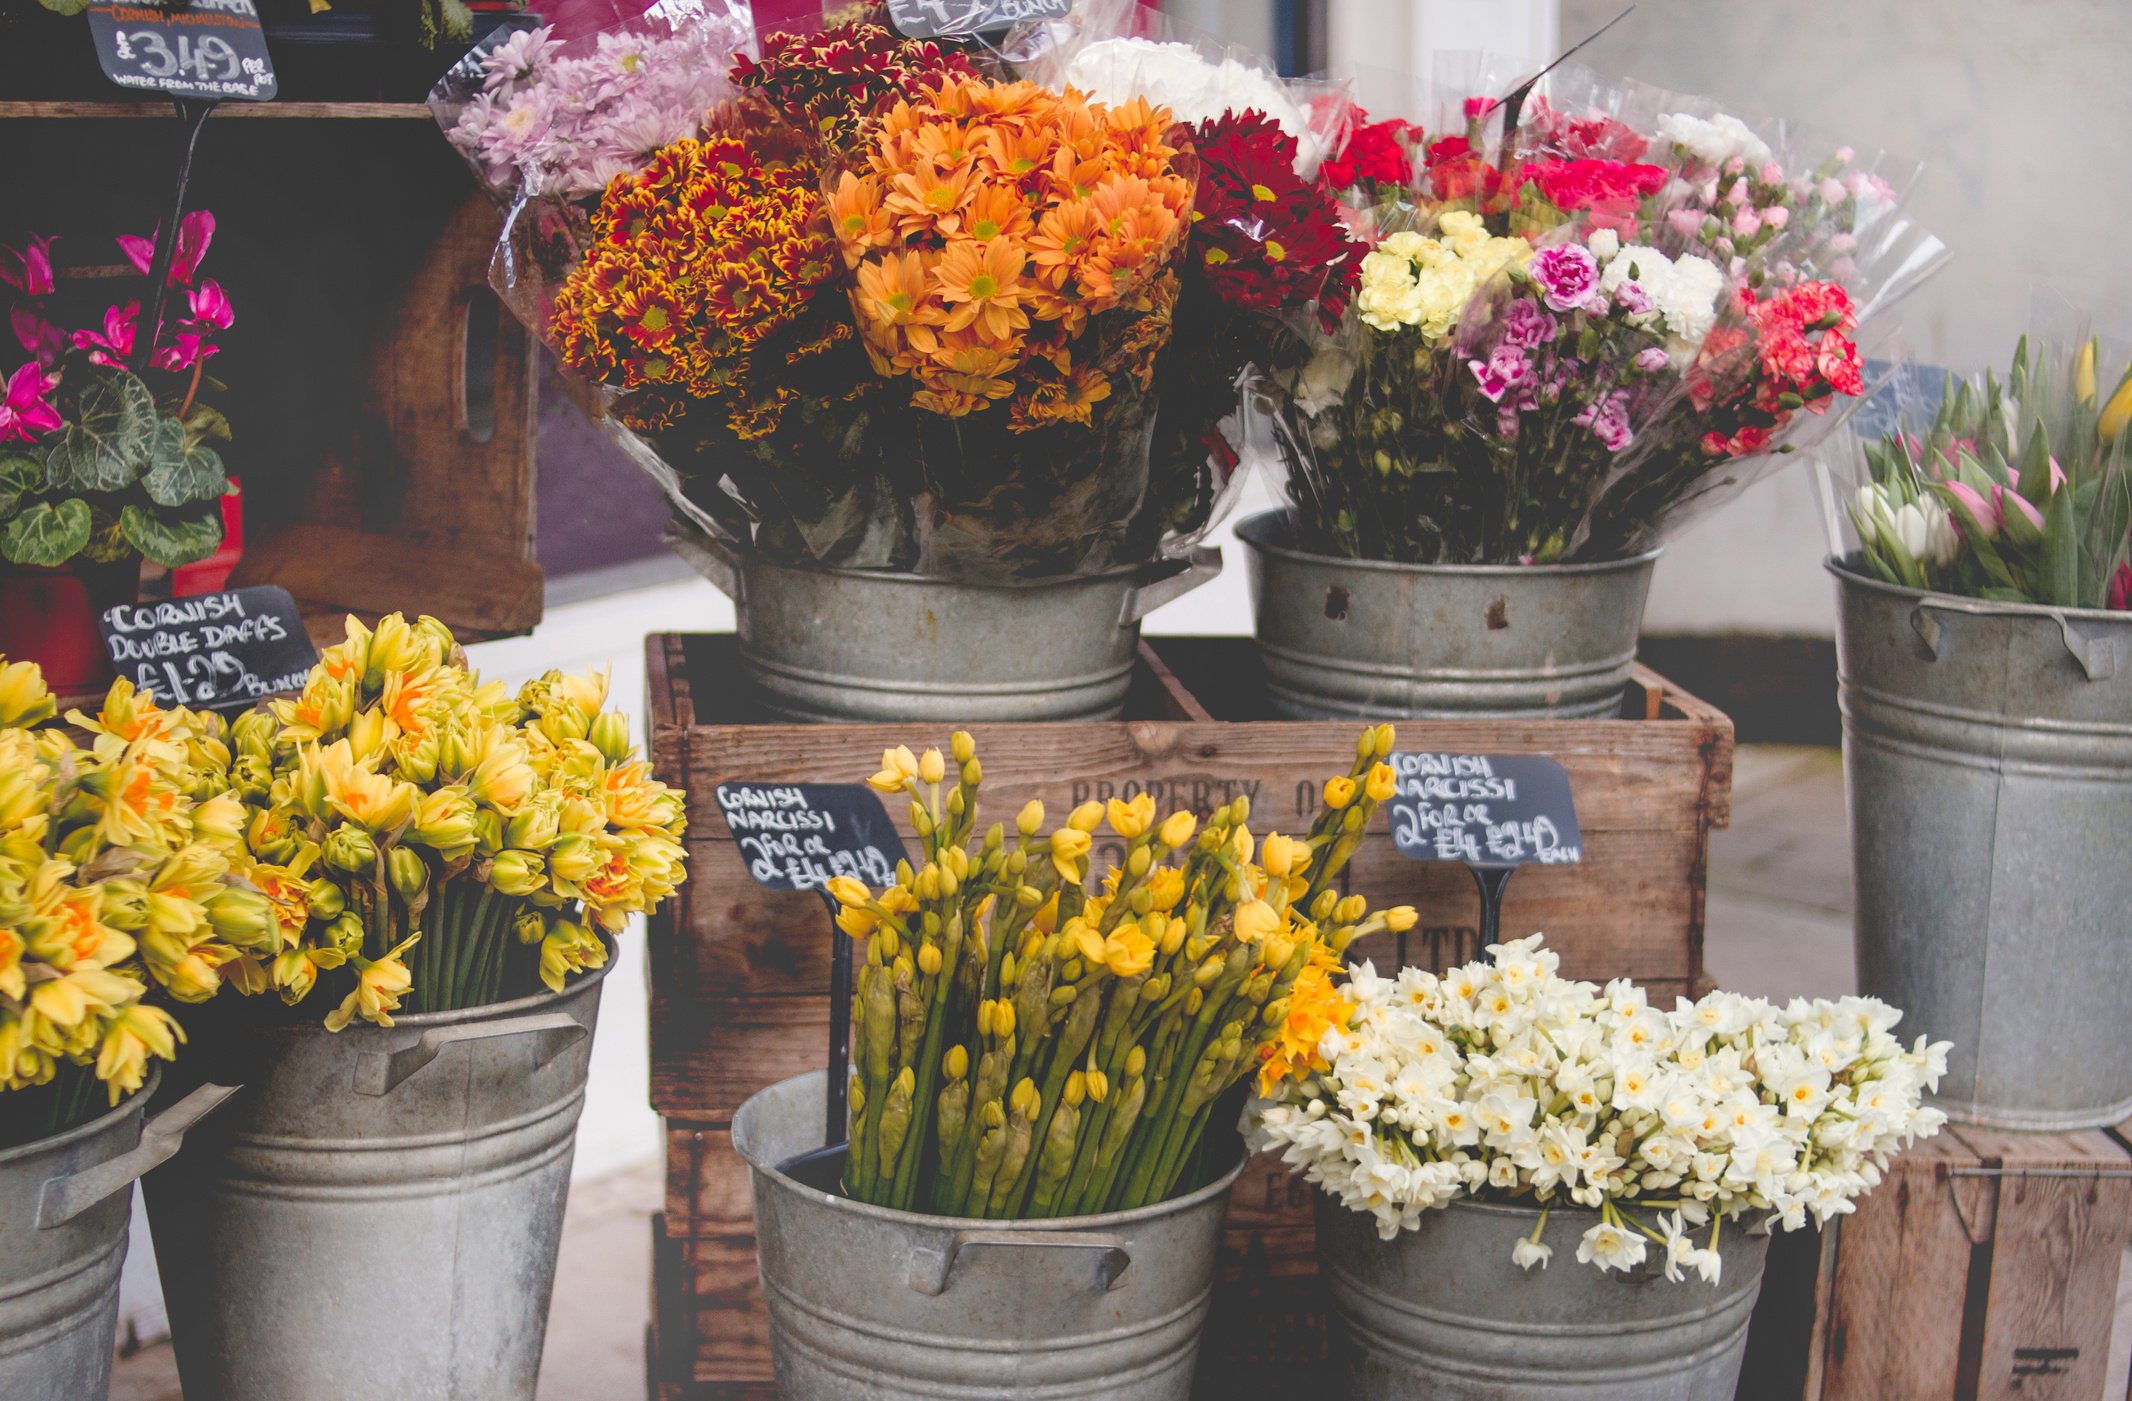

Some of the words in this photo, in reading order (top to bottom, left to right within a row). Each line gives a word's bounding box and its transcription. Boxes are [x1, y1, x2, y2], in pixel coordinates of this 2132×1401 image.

[242, 57, 266, 75] PER
[113, 73, 157, 87] WATER
[159, 78, 194, 91] FROM
[195, 81, 221, 92] THE
[222, 83, 259, 96] BASE
[104, 593, 246, 633] CORNISH
[108, 631, 199, 662] DOUBLE
[200, 614, 288, 648] DAFFS
[1388, 752, 1494, 778] CORNISH
[717, 785, 809, 810] CORNISH
[1394, 775, 1517, 801] NARCISSI
[726, 808, 837, 833] NARCISSI
[1393, 803, 1427, 847] 2
[1418, 801, 1466, 831] FOR
[1463, 803, 1494, 826] OR
[760, 833, 804, 858] FOR
[803, 834, 832, 856] OR
[1432, 825, 1481, 861] £4
[740, 836, 785, 882] 2
